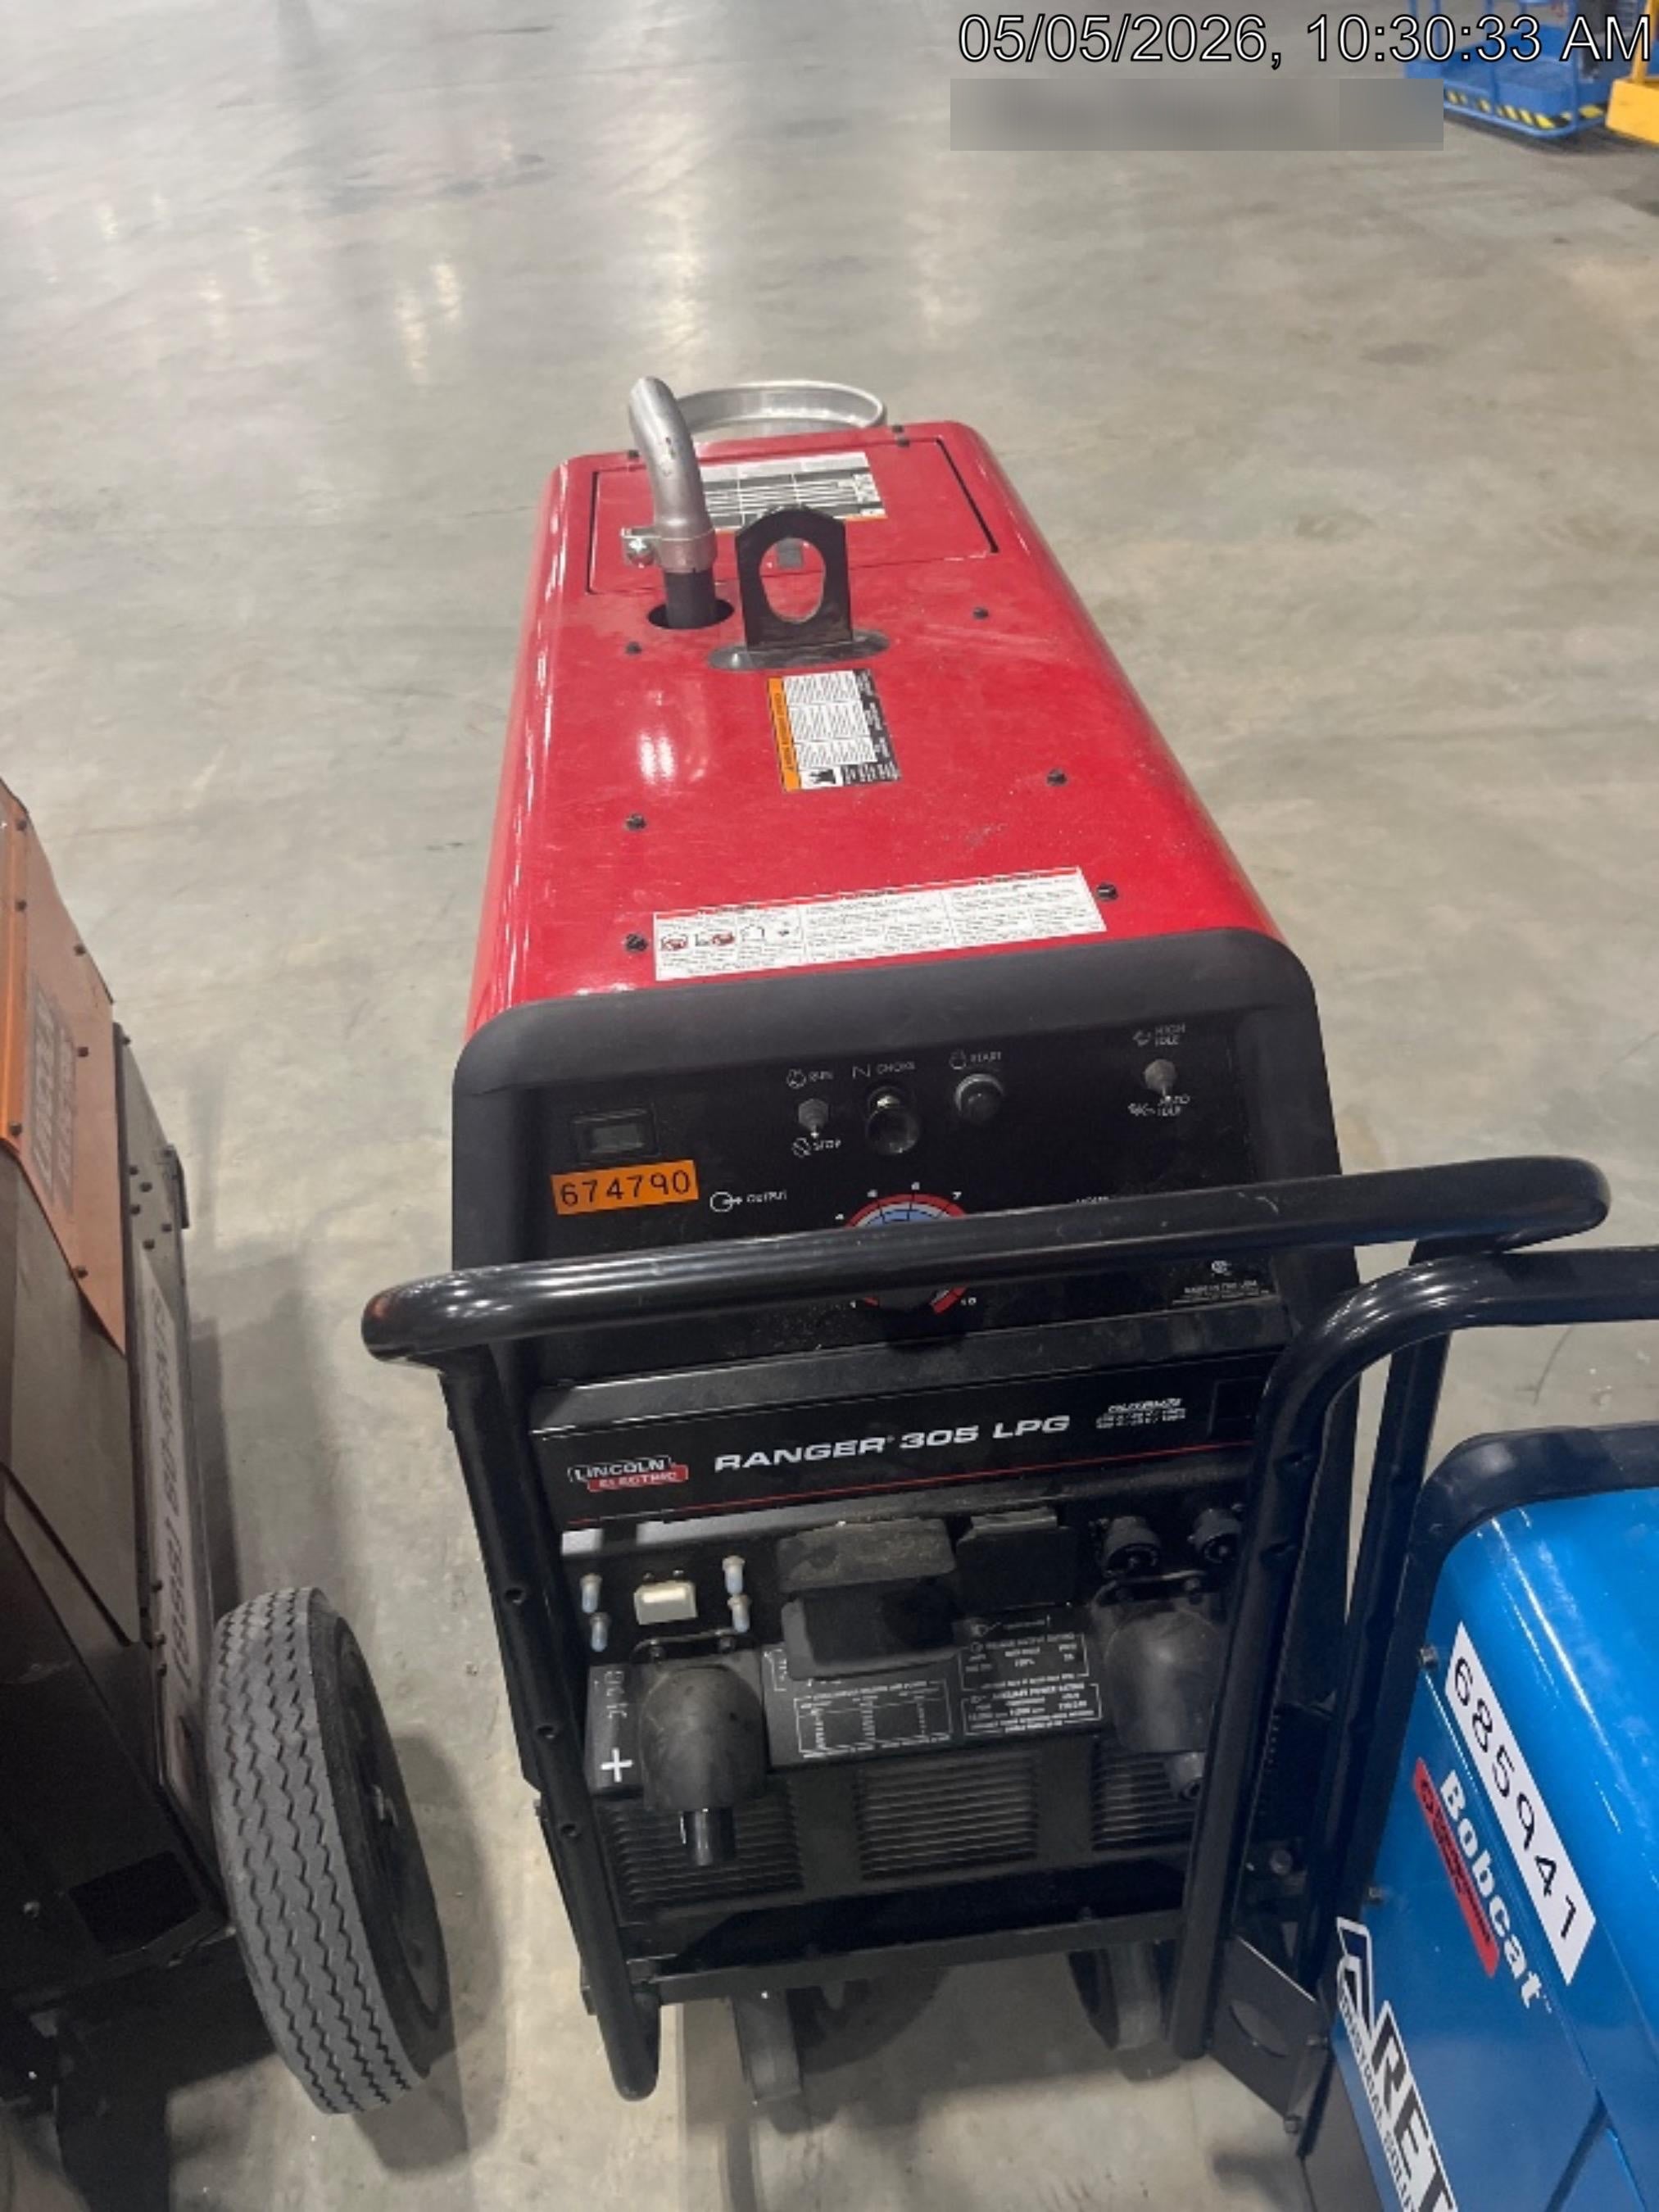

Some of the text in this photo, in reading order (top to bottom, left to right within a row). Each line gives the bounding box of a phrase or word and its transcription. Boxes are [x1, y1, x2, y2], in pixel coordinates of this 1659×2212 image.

[560, 1169, 691, 1208] 674790
[714, 1415, 1071, 1472] RANGER 305 LPG
[574, 1458, 665, 1481] LINCOLN
[598, 1471, 678, 1489] ELECTRIC
[1452, 1655, 1580, 1942] 685941
[1439, 1769, 1543, 2010] Bobcat
